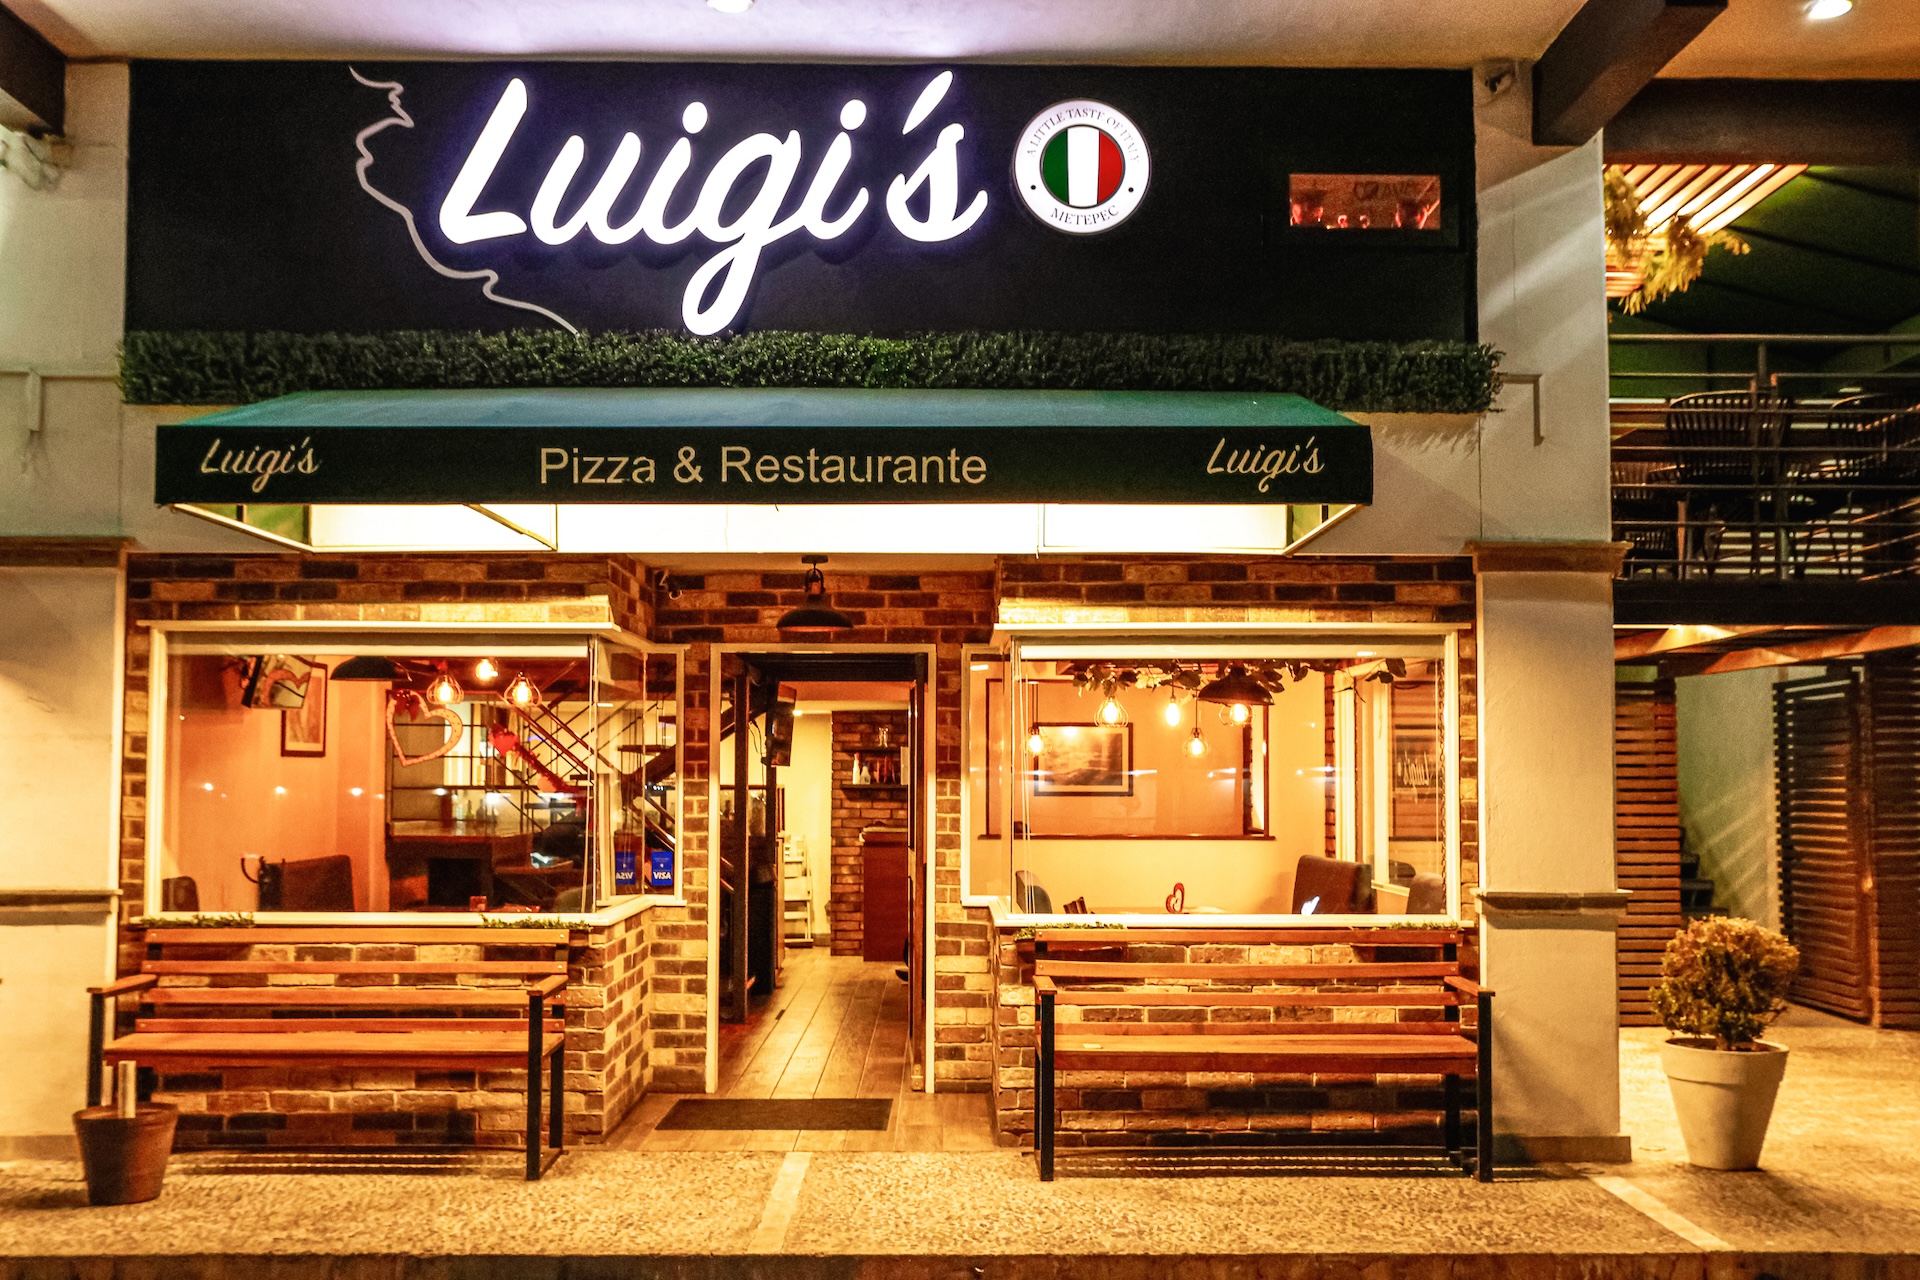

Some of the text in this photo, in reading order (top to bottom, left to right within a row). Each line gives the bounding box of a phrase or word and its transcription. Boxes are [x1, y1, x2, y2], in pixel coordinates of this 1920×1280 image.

[1066, 108, 1105, 121] TASTE
[1106, 117, 1123, 131] OF
[1030, 112, 1066, 147] LITTLE
[1027, 149, 1036, 157] A
[439, 70, 988, 335] Luigi's
[1051, 205, 1119, 225] METEPEC
[201, 436, 322, 493] Luigi's
[539, 445, 987, 485] Pizza & Restaurante
[1206, 436, 1325, 493] Luigi's
[653, 871, 672, 880] VISA
